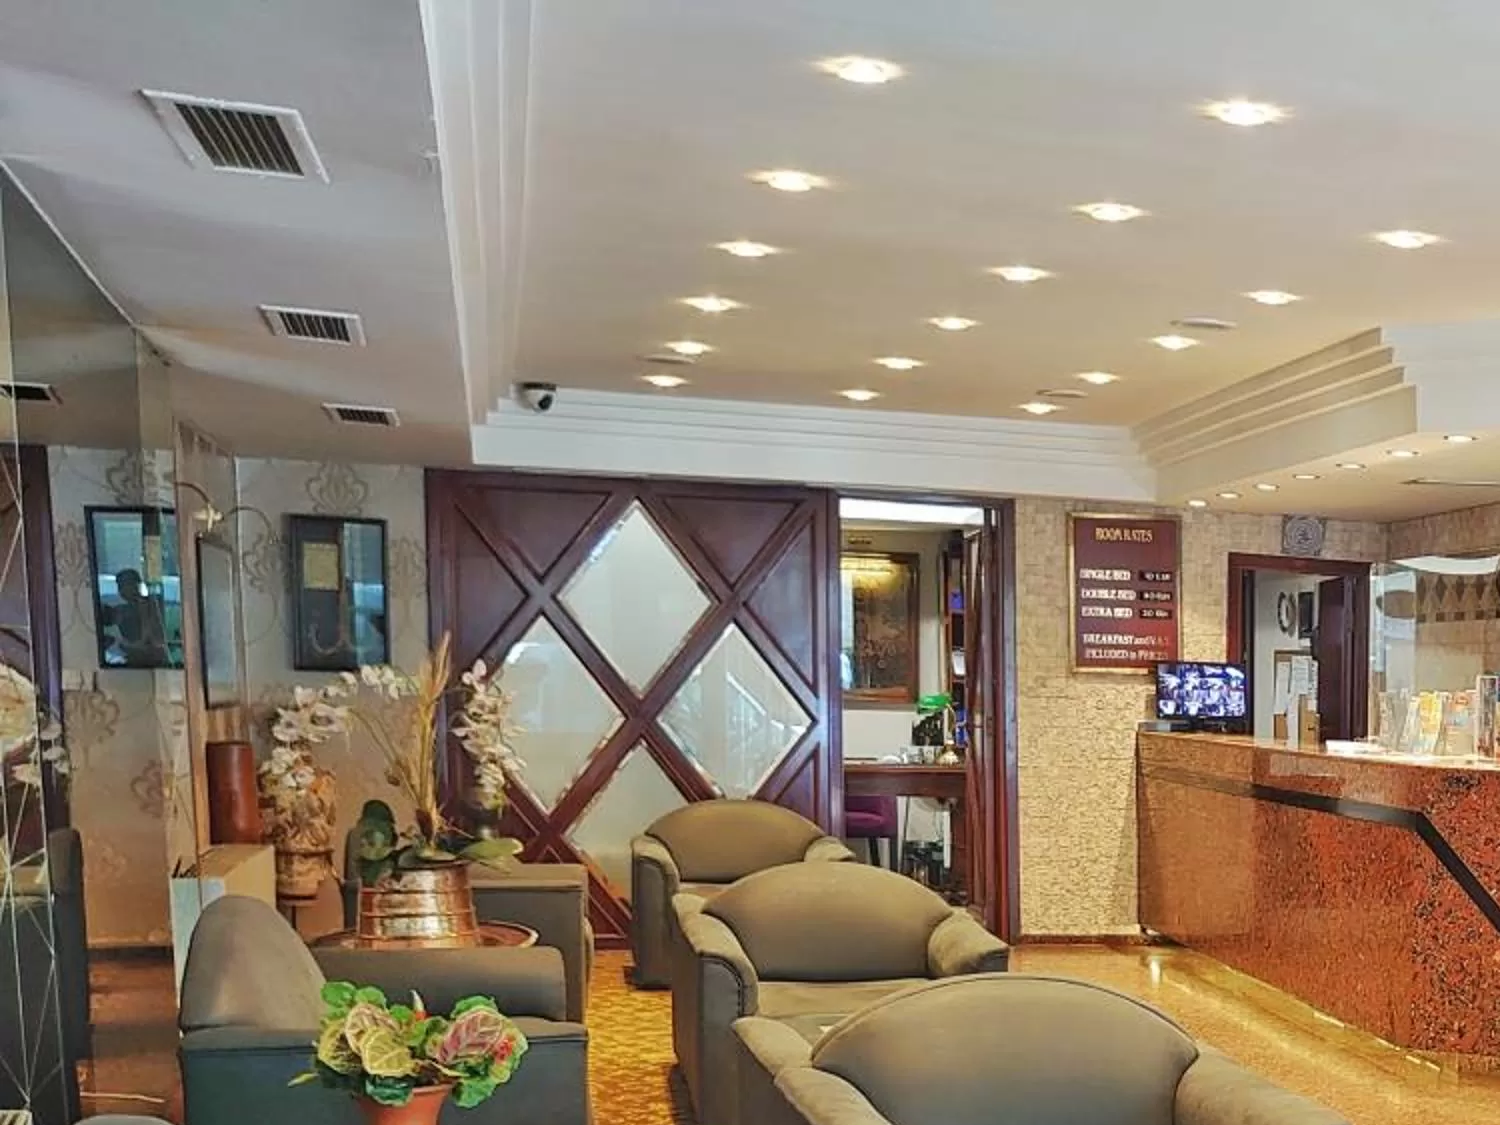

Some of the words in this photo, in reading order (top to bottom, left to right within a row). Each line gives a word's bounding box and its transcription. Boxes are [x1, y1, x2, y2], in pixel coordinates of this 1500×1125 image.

[1095, 527, 1122, 541] ROOM
[1123, 528, 1153, 543] RATES
[1083, 633, 1134, 645] BREAKFAST
